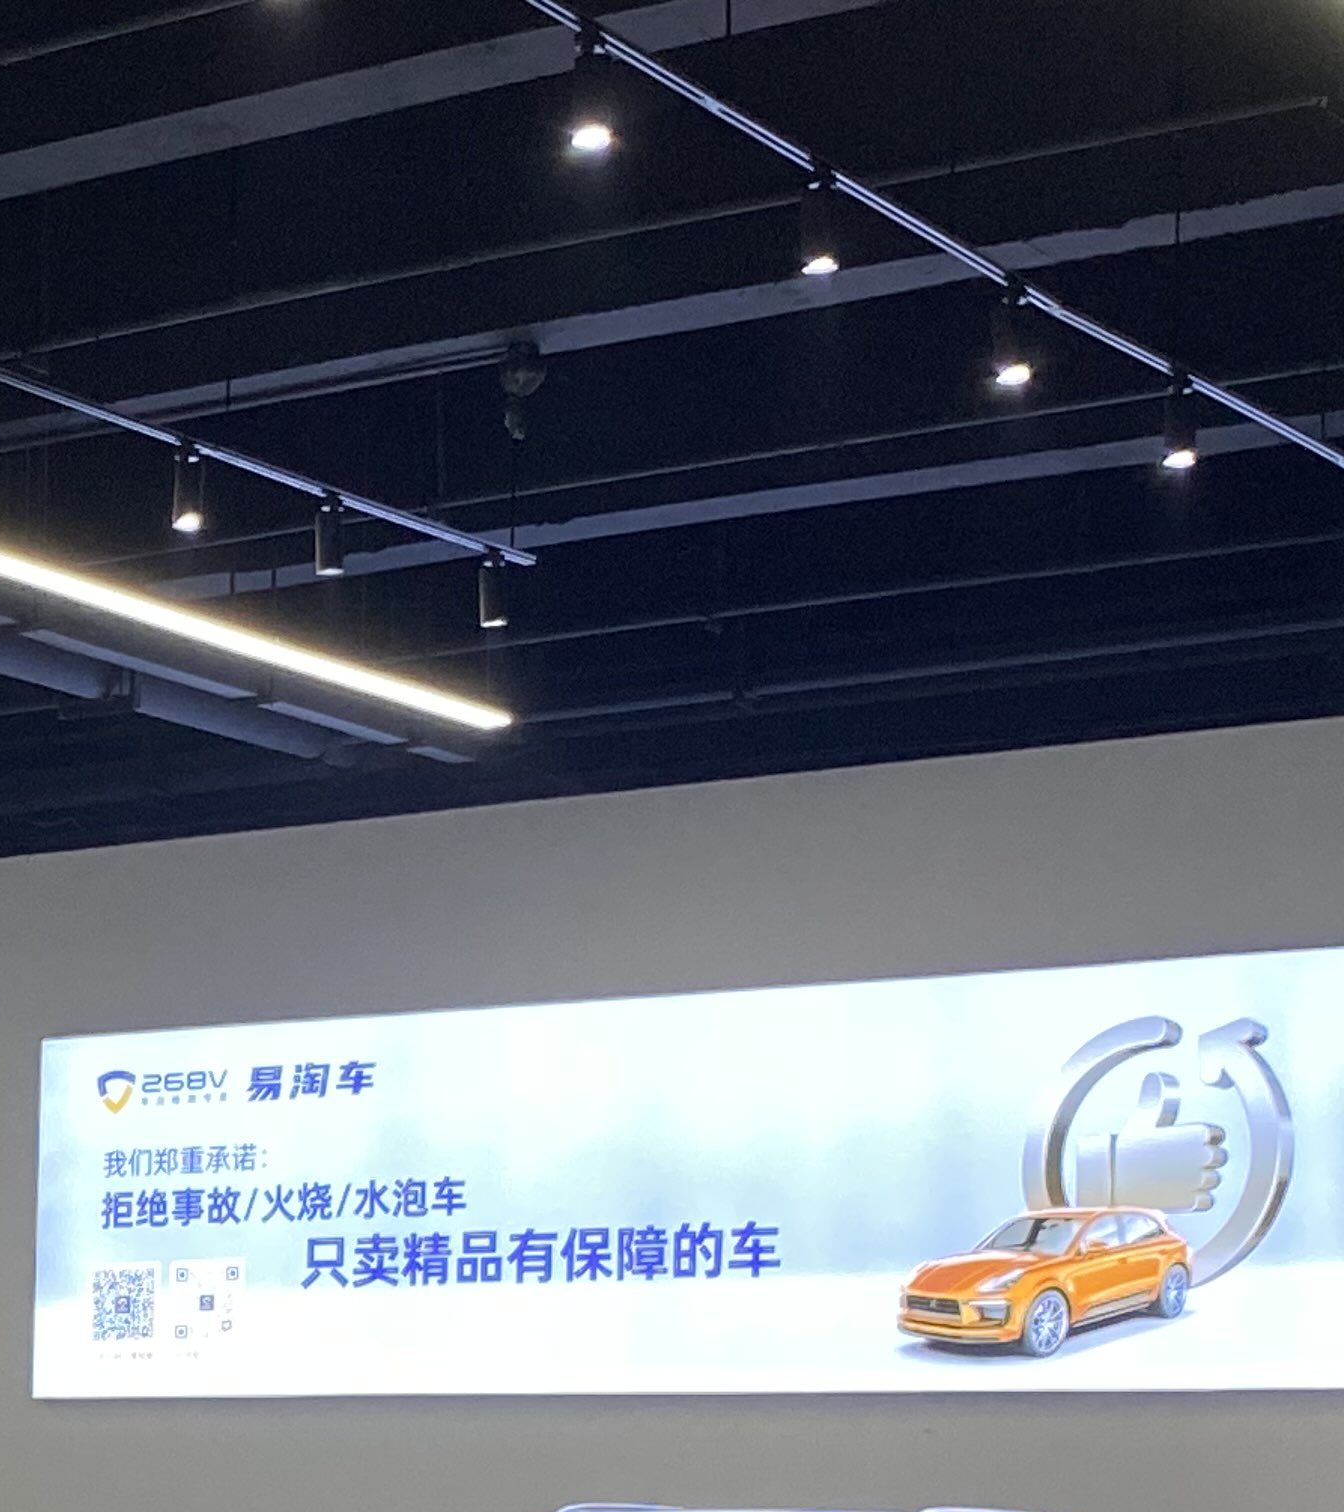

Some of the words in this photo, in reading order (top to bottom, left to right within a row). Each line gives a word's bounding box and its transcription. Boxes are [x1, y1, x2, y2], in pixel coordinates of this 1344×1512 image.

[141, 1068, 228, 1093] 268V
[246, 1060, 377, 1102] 易淘车
[103, 1143, 268, 1178] 我们郑重承诺：
[101, 1176, 467, 1229] 拒绝事故/火烧/水泡车
[300, 1221, 782, 1289] 只卖精品有保障的车
